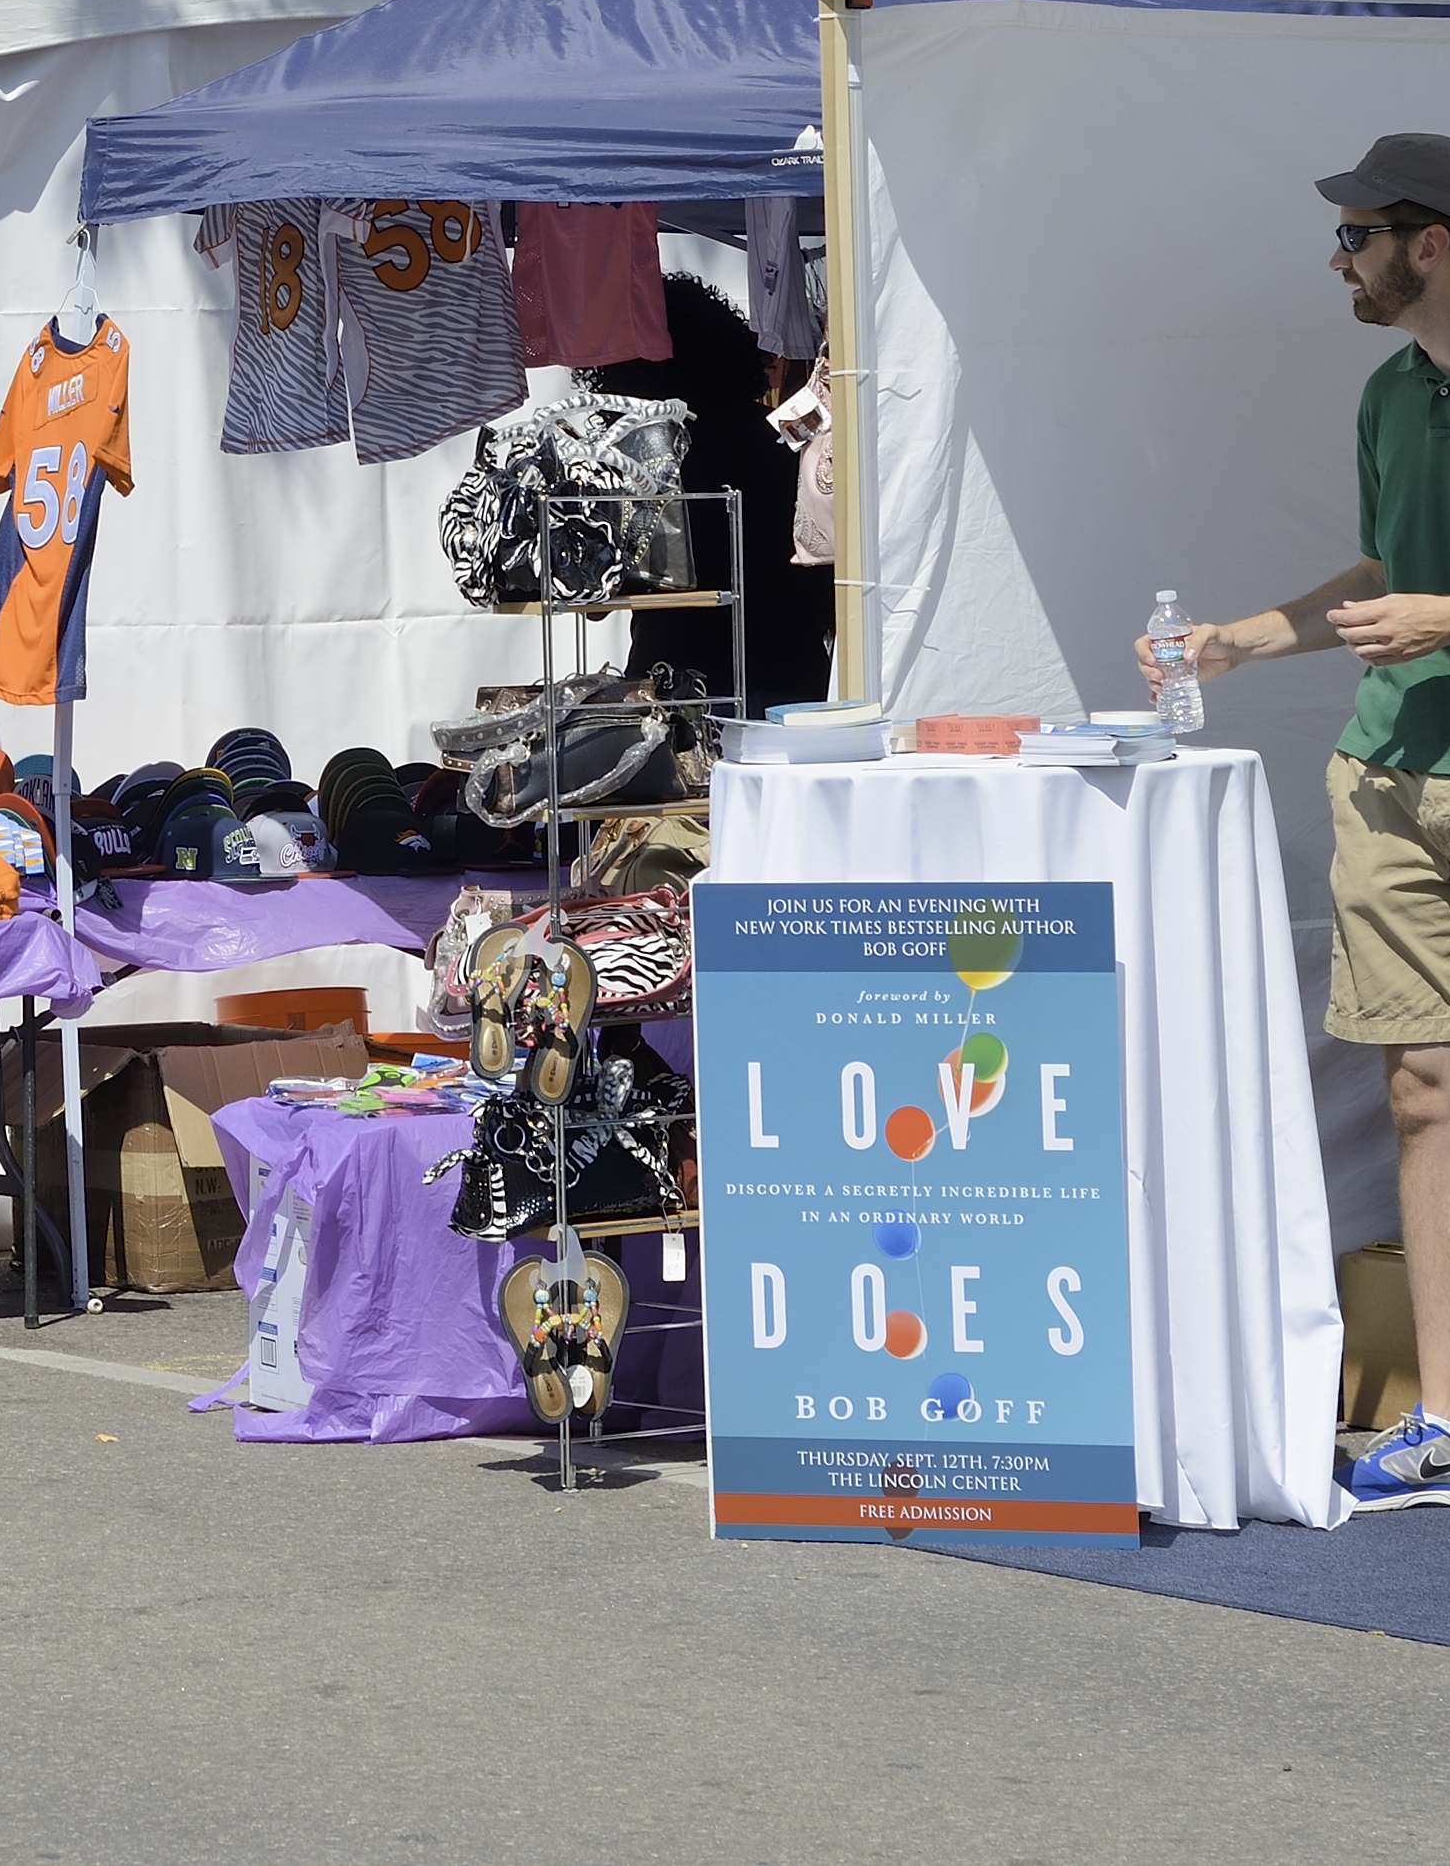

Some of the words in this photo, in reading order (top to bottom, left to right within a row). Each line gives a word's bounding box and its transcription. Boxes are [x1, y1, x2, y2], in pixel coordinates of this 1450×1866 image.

[770, 156, 800, 167] OZARK
[46, 372, 85, 417] MILLER
[16, 440, 88, 550] 58
[766, 897, 808, 918] JOIN
[810, 897, 835, 915] US
[838, 897, 874, 915] FOR
[876, 898, 902, 913] AN
[908, 898, 986, 914] EVENING
[990, 898, 1040, 913] WITH
[734, 919, 777, 936] NEW
[778, 919, 828, 936] YORK
[830, 920, 882, 935] TIMES
[887, 919, 996, 935] BESTSELLING
[1000, 919, 1077, 935] AUTHOR
[863, 941, 897, 957] BOB
[901, 941, 947, 957] GOFF
[856, 990, 928, 1004] foreword
[934, 990, 951, 1004] by
[816, 1012, 902, 1024] DONALD
[915, 1012, 997, 1026] MILLER
[747, 1058, 1074, 1154] LOVE
[750, 1262, 1085, 1359] DOES
[795, 1395, 887, 1421] BOB
[920, 1392, 1046, 1424] GOFF
[796, 1450, 892, 1468] THURSDAY,
[896, 1453, 937, 1468] SEPT.
[942, 1454, 988, 1470] 12TH,
[991, 1455, 1050, 1471] 7:30PM
[827, 1471, 863, 1487] THE
[868, 1473, 947, 1489] LINCOLN
[952, 1475, 1022, 1491] CENTER
[859, 1504, 895, 1519] FREE
[899, 1505, 992, 1521] ADMISSION
